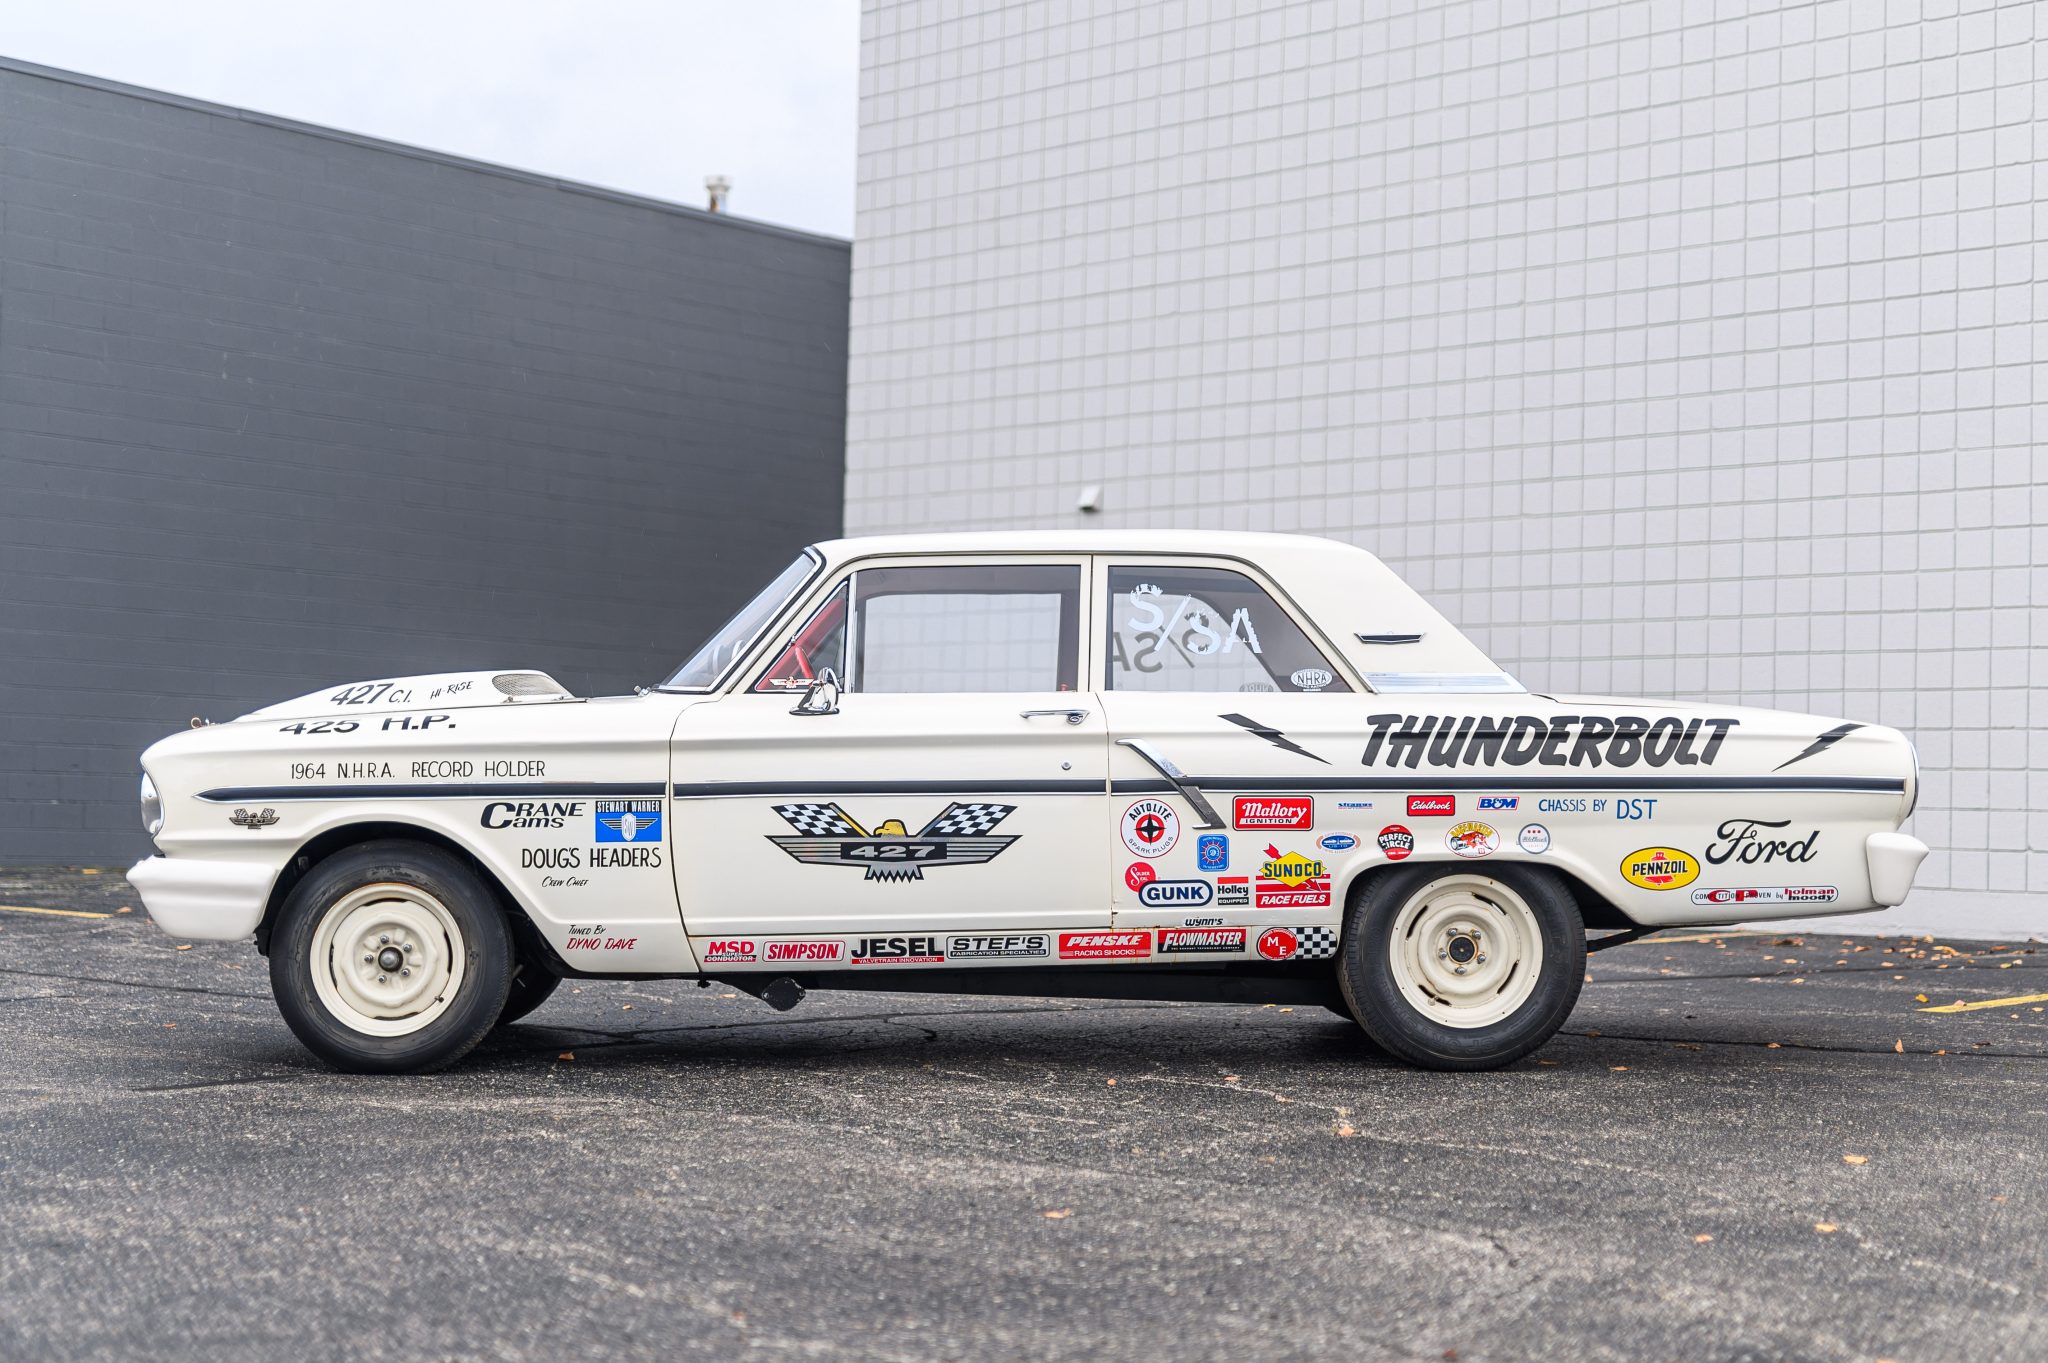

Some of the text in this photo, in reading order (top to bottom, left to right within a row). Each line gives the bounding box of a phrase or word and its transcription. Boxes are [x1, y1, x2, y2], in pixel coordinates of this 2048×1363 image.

[1297, 672, 1327, 685] NHRA
[331, 683, 412, 705] 427 C.I.
[280, 715, 456, 735] 425 H.P.
[1361, 714, 1740, 769] THUNDERBOLT
[291, 760, 545, 779] 1964 N.H.R.A. RECORD HOLDER
[597, 800, 660, 813] STEWART WARNER
[1242, 802, 1307, 818] Mallory
[1411, 800, 1451, 810] Edelbrock
[1479, 798, 1518, 809] B&M
[1538, 799, 1657, 820] CHASSIS BY DST
[1128, 803, 1172, 821] AUTOLITE
[1379, 833, 1412, 843] PERFECT
[1705, 819, 1820, 865] Ford
[850, 845, 935, 858] 427
[1128, 836, 1174, 854] SPARK PLUGS
[522, 847, 662, 868] DOUG'S HEADERS
[1264, 861, 1322, 878] SUNOCO
[1631, 861, 1688, 876] PENNZOIL
[1146, 886, 1204, 900] GUNK
[1217, 885, 1249, 896] Holley
[1785, 888, 1834, 898] holman
[1261, 894, 1326, 905] RACE FUELS
[1788, 894, 1834, 902] moody
[566, 937, 637, 950] DYNO DAVE
[708, 941, 754, 954] MSD
[851, 937, 944, 958] JESEL
[953, 937, 1044, 950] STEF'S
[1066, 935, 1143, 947] PENSKE
[1162, 931, 1242, 951] FLOWMASTER
[1267, 937, 1279, 946] M
[768, 944, 839, 959] SIMPSON
[1074, 949, 1102, 957] RACING
[1279, 946, 1287, 955] E
